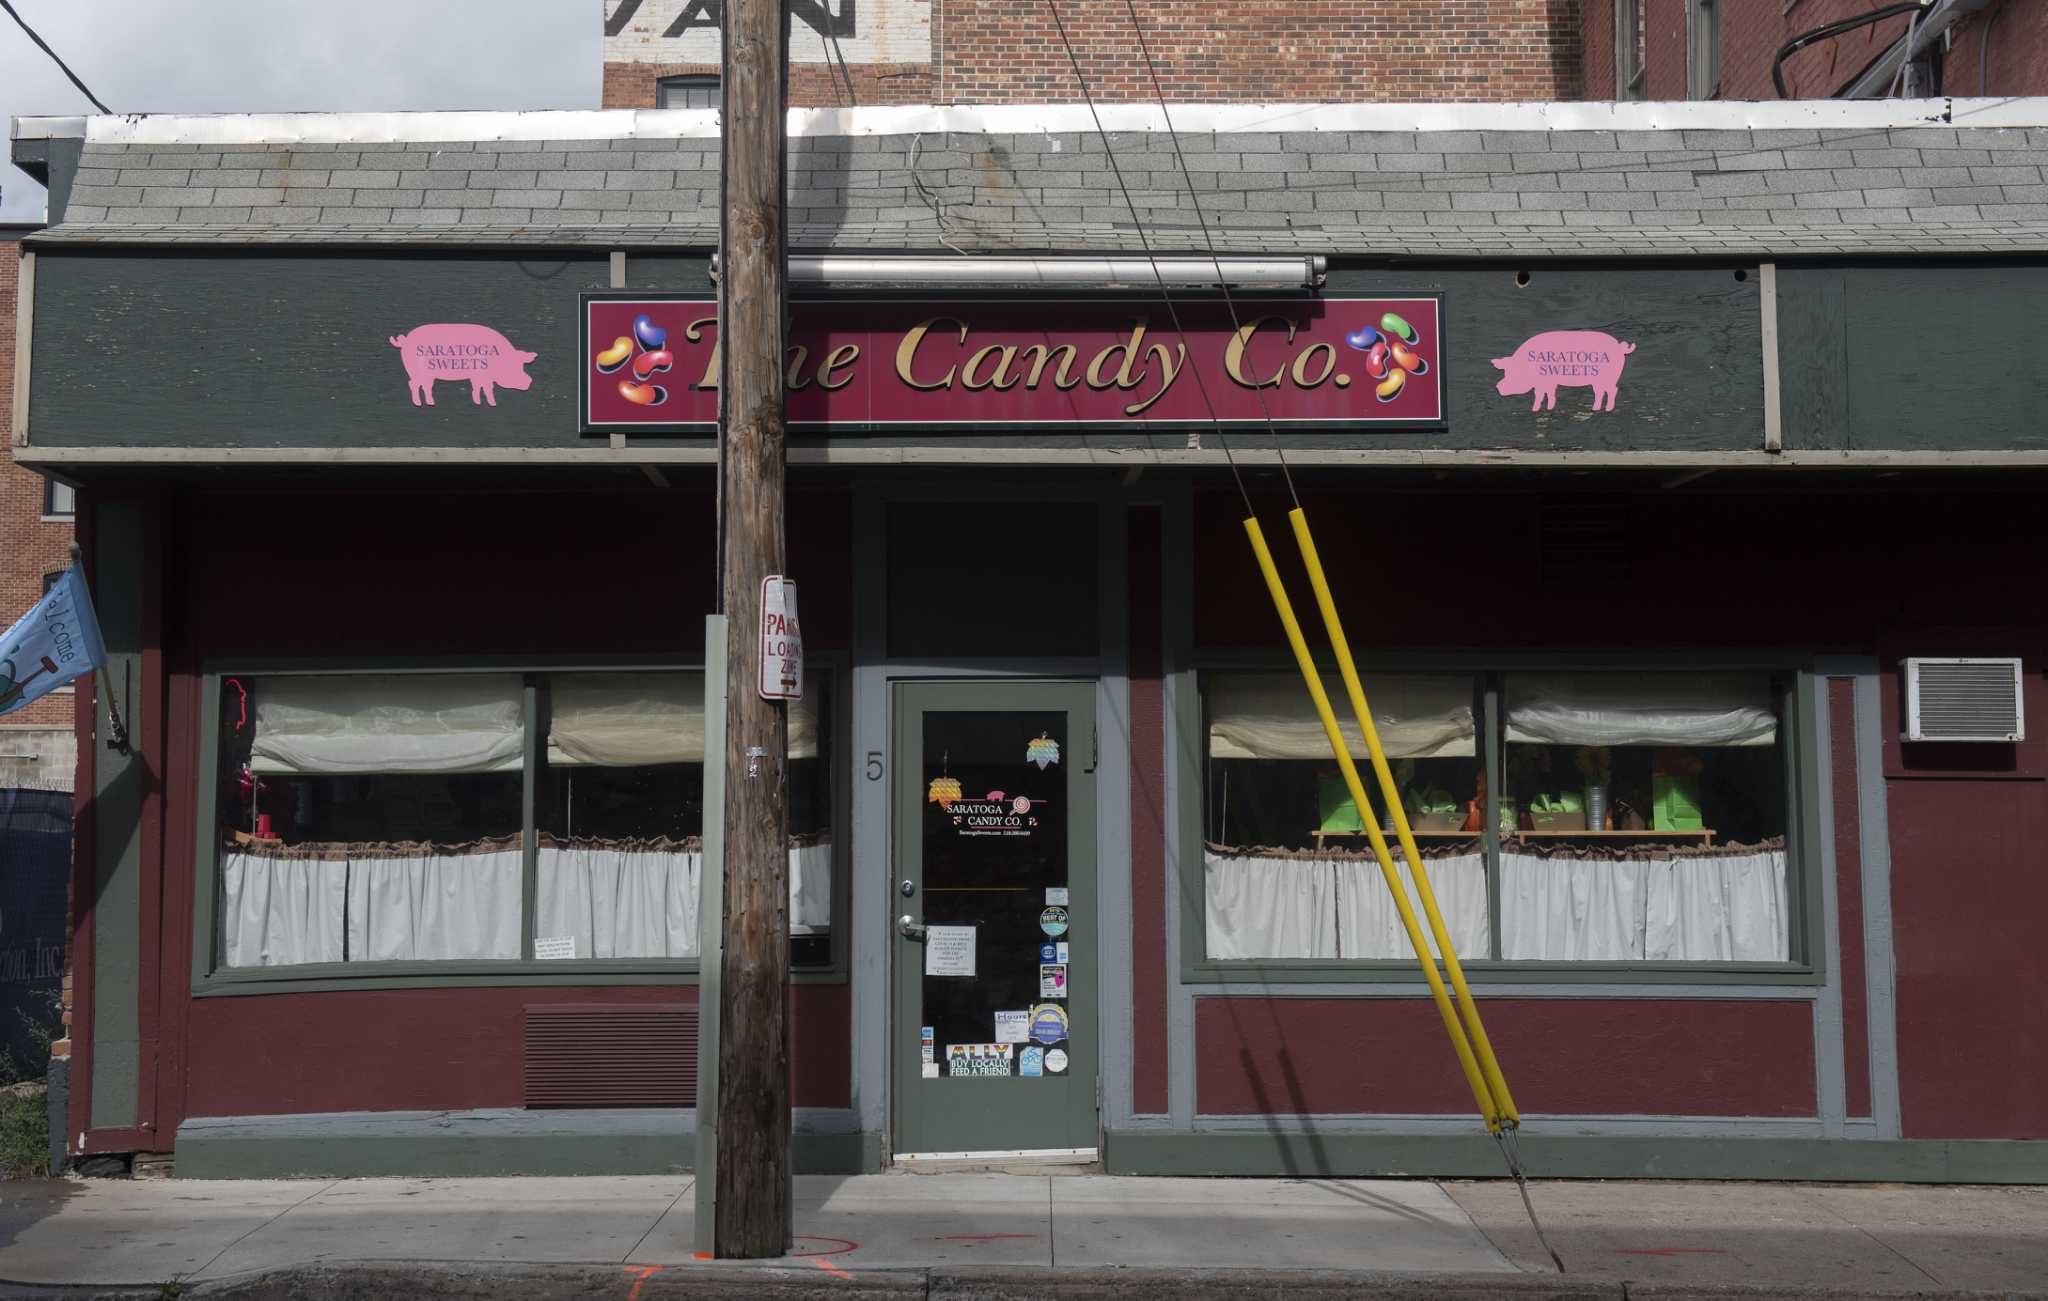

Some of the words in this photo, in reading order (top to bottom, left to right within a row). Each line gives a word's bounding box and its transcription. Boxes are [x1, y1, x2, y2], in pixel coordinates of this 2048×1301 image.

[416, 344, 500, 357] SARATOGA
[1528, 351, 1610, 363] SARATOGA
[428, 358, 488, 370] SWEETS
[895, 316, 1186, 416] Candy
[1224, 314, 1351, 391] Co.
[1539, 365, 1599, 376] SWEETS
[867, 751, 883, 781] 5
[947, 804, 1003, 814] SARATOGA
[967, 816, 1003, 826] CANDY
[1004, 816, 1022, 826] CO.
[997, 1013, 1027, 1021] Hours
[951, 1045, 1009, 1060] ALLY
[951, 1060, 969, 1068] BUY
[971, 1060, 1009, 1068] LOCALLY
[952, 1068, 970, 1076] FEED
[971, 1068, 978, 1076] A
